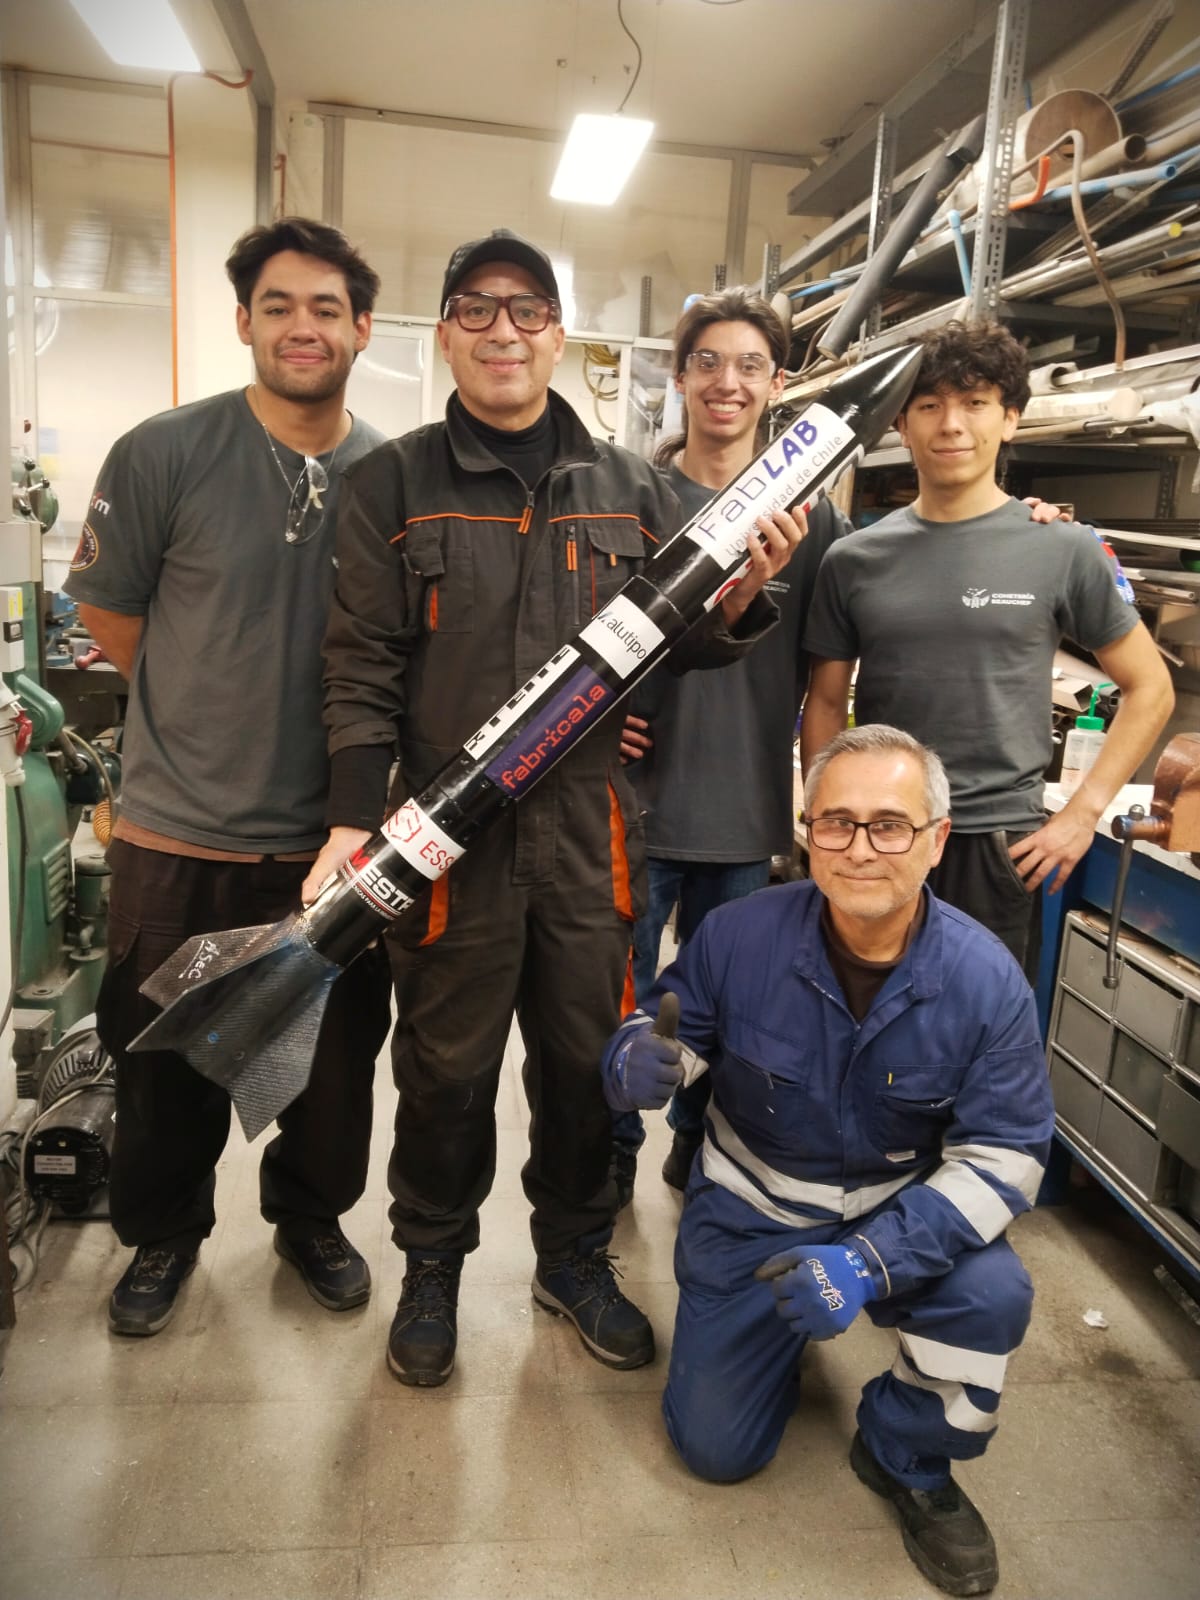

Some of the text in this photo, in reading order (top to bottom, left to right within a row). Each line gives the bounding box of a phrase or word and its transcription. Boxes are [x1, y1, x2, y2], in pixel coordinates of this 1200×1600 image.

[698, 420, 818, 541] FabLAB
[726, 484, 795, 557] Univesidad
[797, 467, 812, 486] de
[812, 435, 843, 467] Chile
[606, 618, 647, 660] alutipo
[807, 1258, 845, 1311] NINJA
